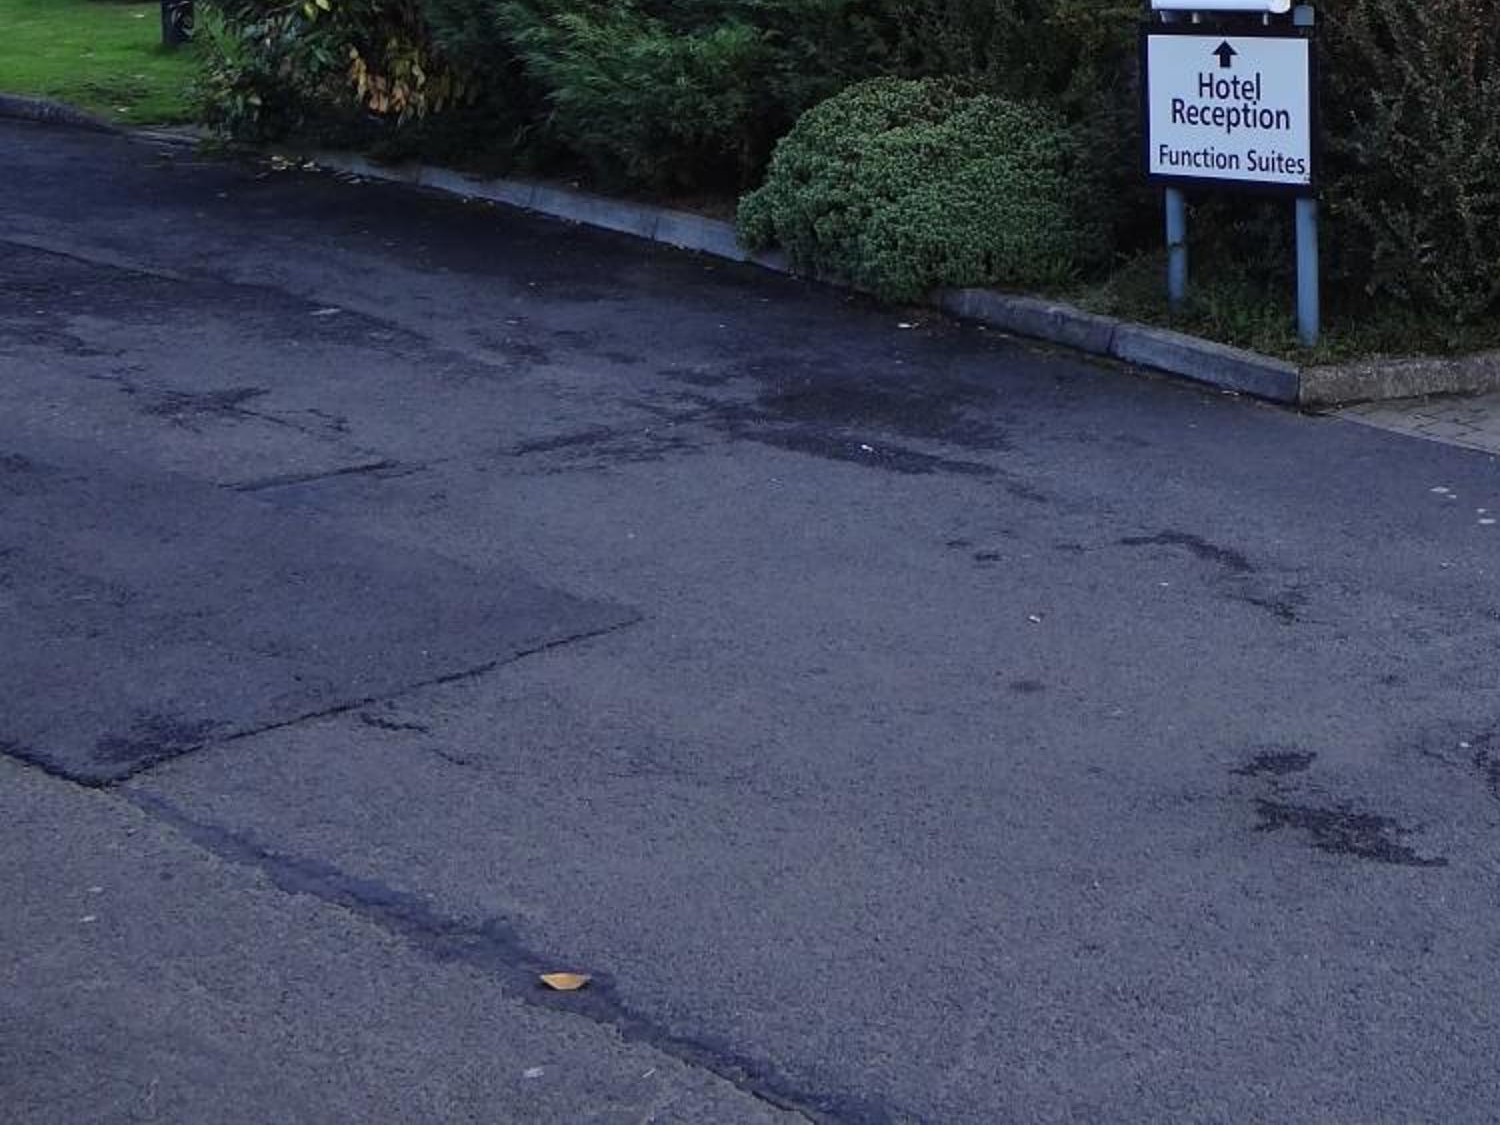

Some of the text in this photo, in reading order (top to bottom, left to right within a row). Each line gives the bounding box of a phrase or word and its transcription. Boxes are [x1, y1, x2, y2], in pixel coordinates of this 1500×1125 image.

[1198, 72, 1261, 101] Hotel
[1171, 98, 1290, 134] Reception
[1159, 144, 1305, 174] Function Suites
